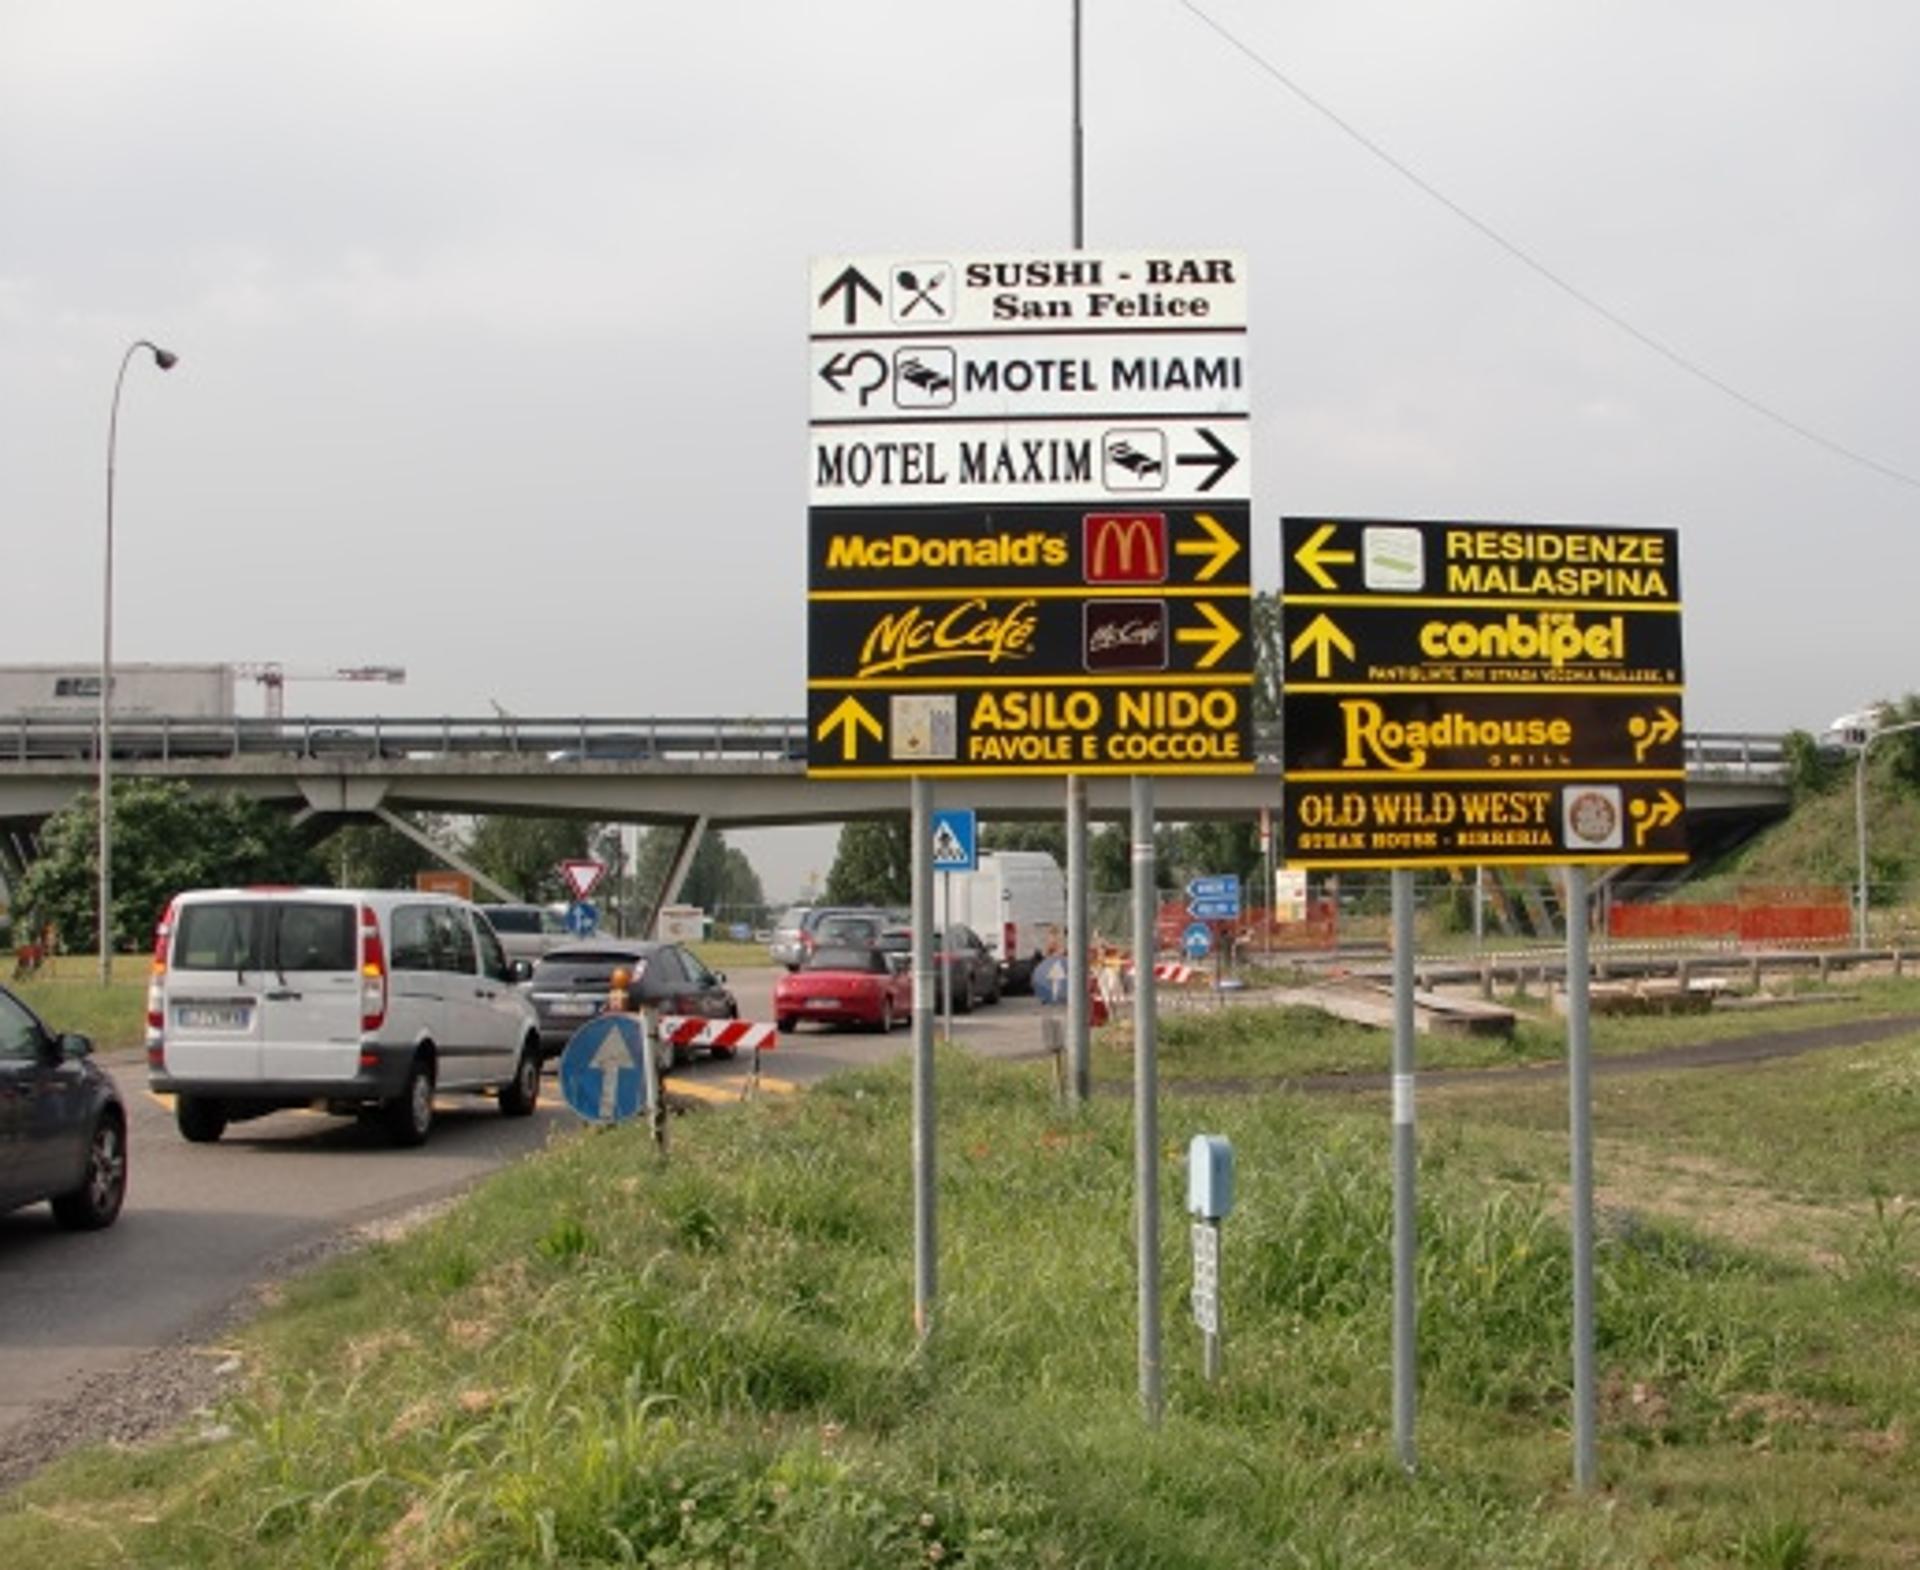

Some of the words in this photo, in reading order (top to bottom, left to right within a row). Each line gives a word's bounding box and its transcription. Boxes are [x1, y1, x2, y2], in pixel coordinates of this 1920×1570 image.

[966, 262, 1102, 288] SUSHI
[1146, 259, 1235, 285] BAR
[992, 294, 1072, 319] San
[1088, 291, 1210, 317] Felice
[964, 361, 1097, 393] MOTEL
[1112, 357, 1242, 391] MIAMI
[817, 443, 946, 487] MOTEL
[959, 439, 1092, 484] MAXIM
[827, 534, 1068, 568] McDonald's
[1446, 530, 1664, 564] RESIDENZE
[1447, 565, 1667, 597] MALASPINA
[970, 692, 1101, 730] ASILO
[1118, 691, 1237, 728] NIDO
[970, 736, 1072, 759] FAVOLE
[1082, 736, 1097, 759] E
[1107, 733, 1240, 759] COCCOLE
[1339, 700, 1571, 770] Roadhouse
[1299, 794, 1366, 826] OLD
[1372, 793, 1456, 825] WILD
[1461, 791, 1552, 823] WEST
[1299, 833, 1366, 849] STEAK
